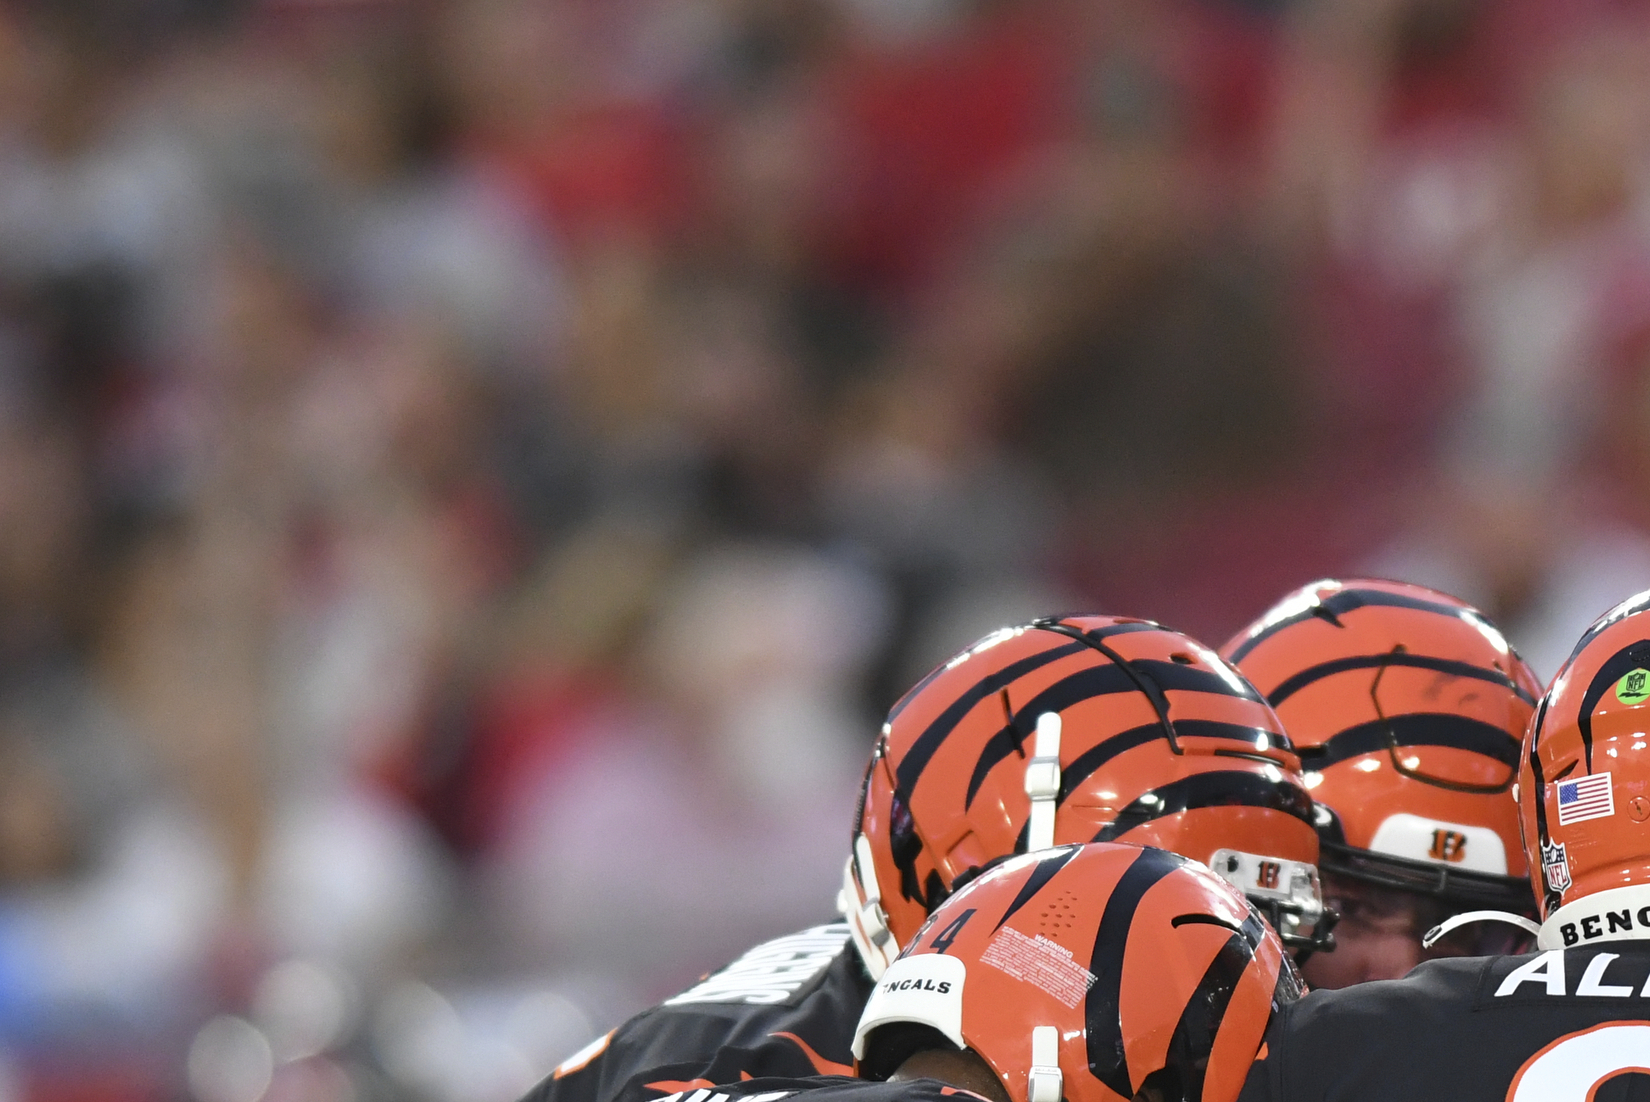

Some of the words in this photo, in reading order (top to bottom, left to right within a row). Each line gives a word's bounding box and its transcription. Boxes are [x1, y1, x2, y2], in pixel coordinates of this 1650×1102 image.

[1548, 863, 1567, 888] NFL
[1034, 934, 1074, 959] WARNING
[883, 979, 952, 994] NGALS
